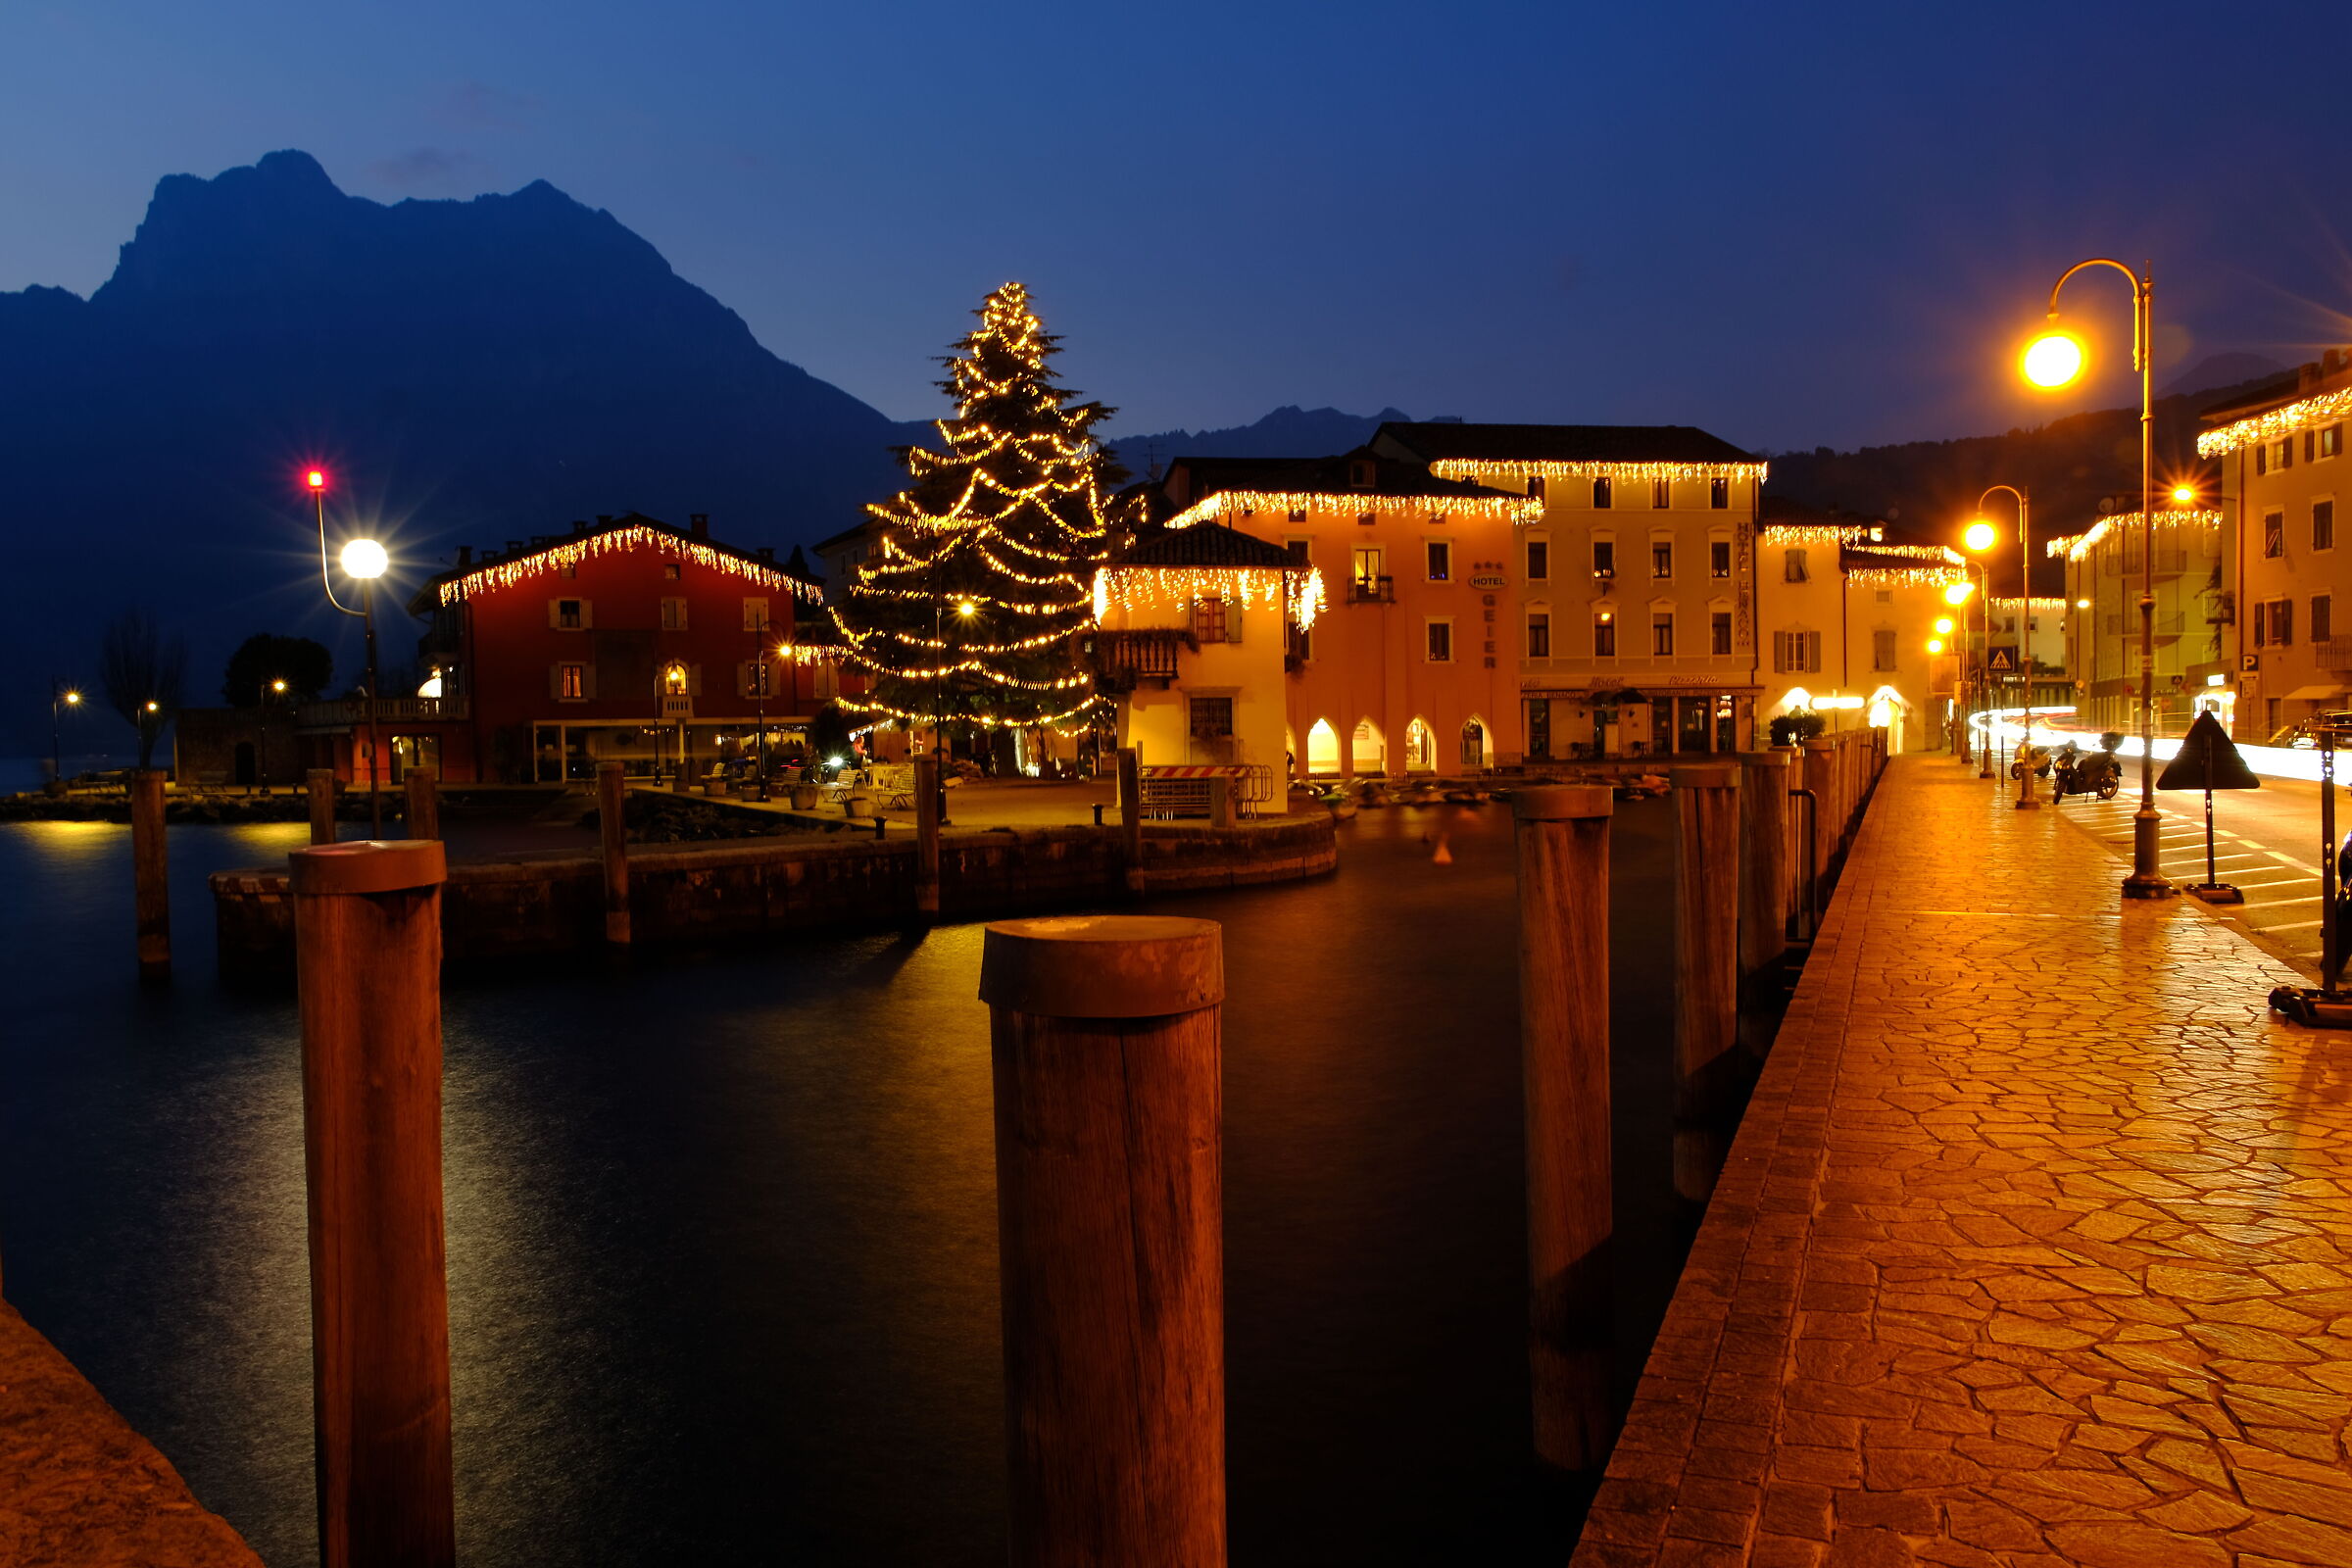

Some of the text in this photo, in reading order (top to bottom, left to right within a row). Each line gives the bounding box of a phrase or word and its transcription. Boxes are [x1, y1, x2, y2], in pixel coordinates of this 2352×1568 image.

[1473, 577, 1505, 586] HOTEL
[1482, 594, 1496, 669] GEIER
[2243, 656, 2256, 670] P
